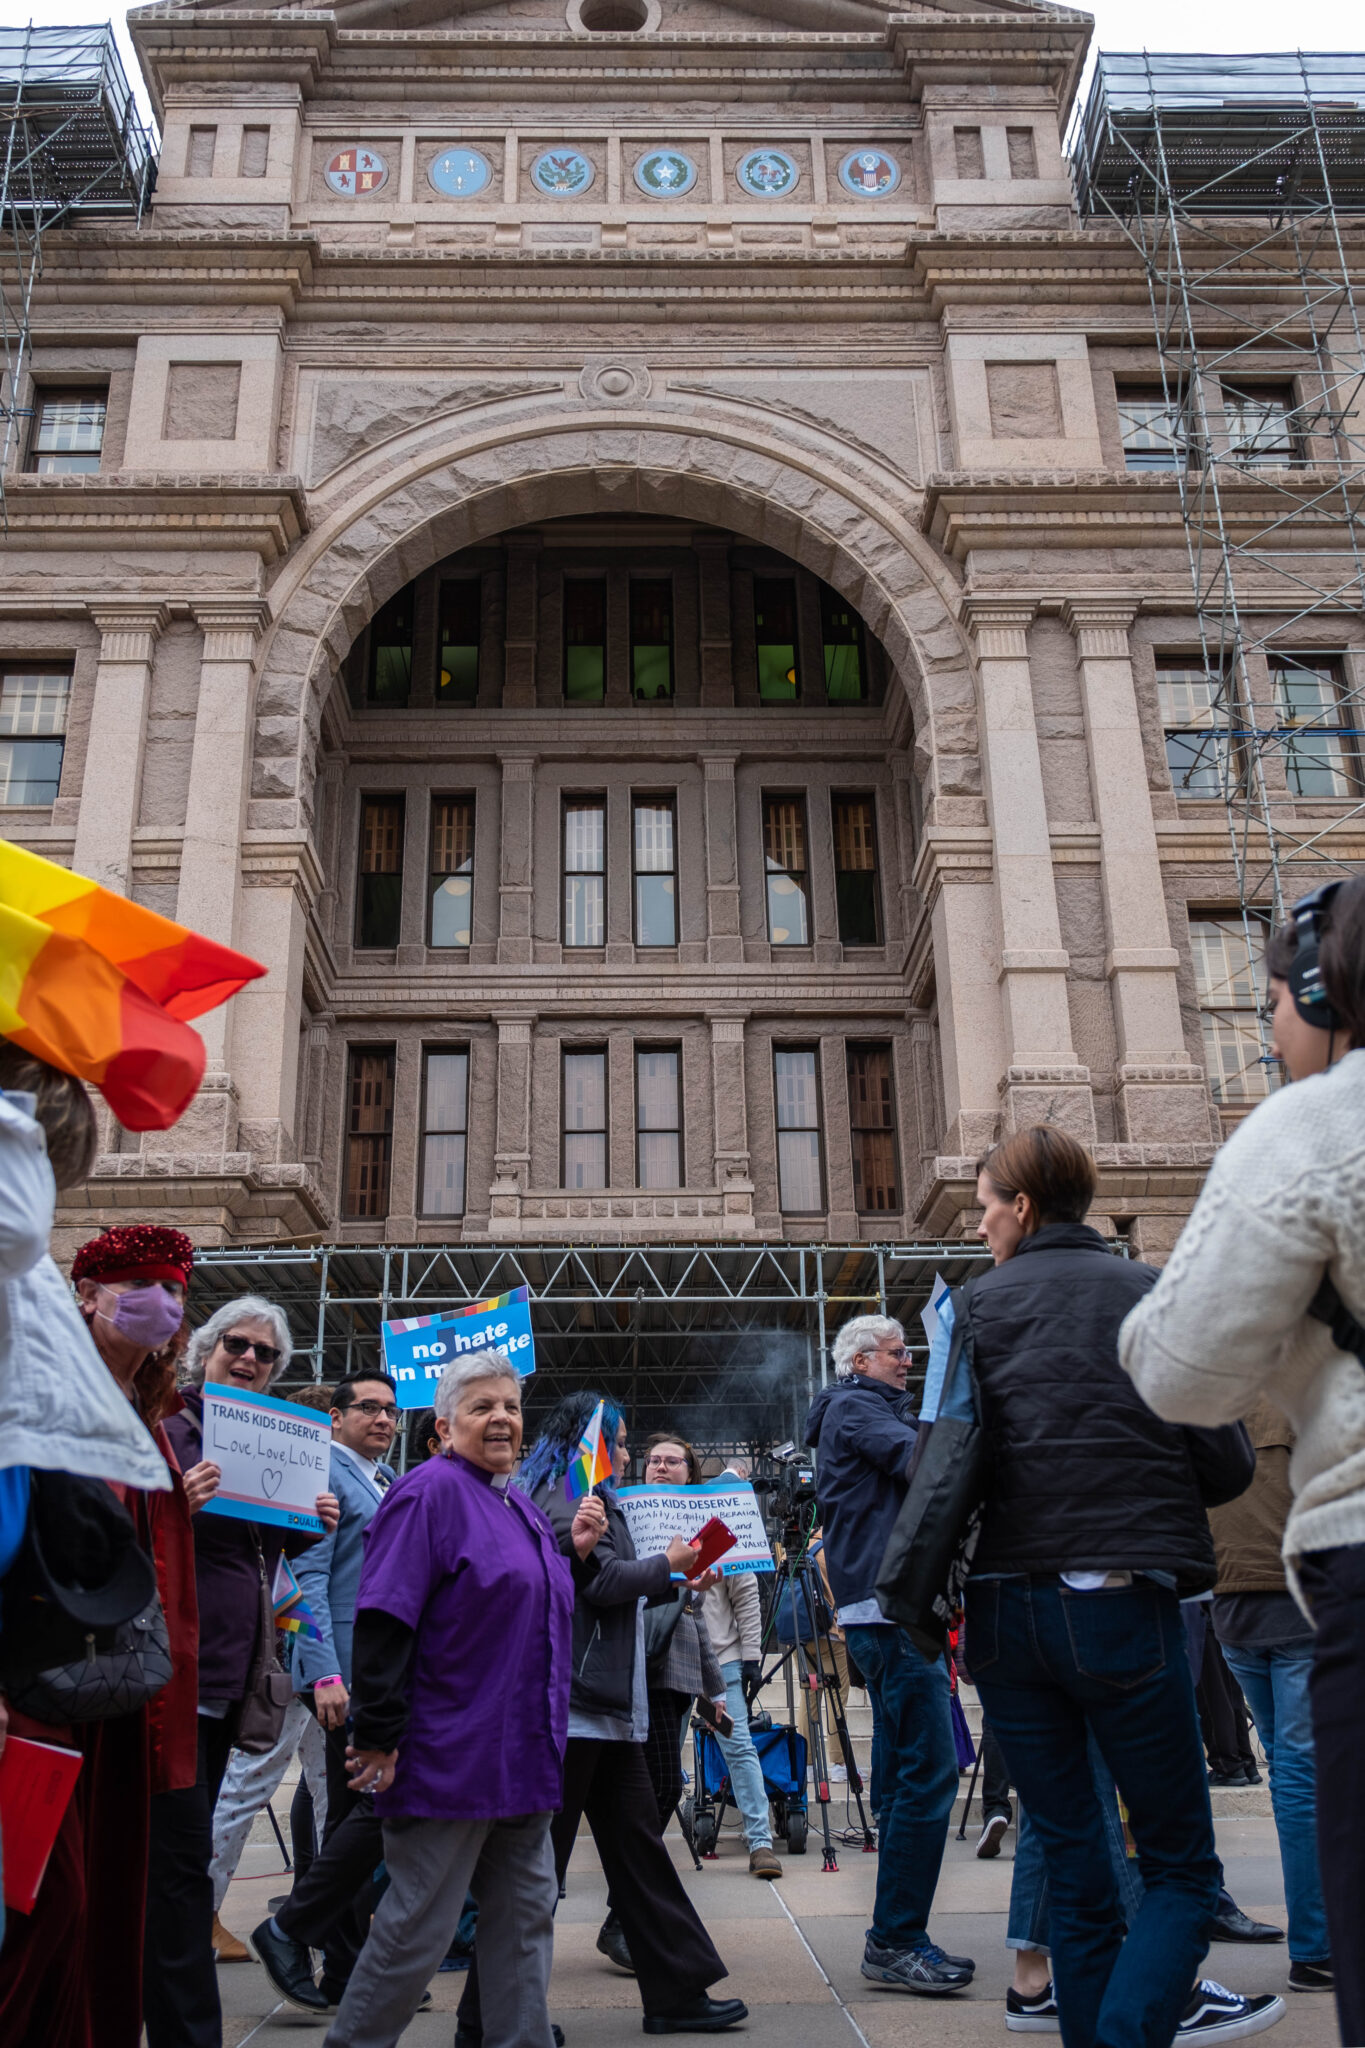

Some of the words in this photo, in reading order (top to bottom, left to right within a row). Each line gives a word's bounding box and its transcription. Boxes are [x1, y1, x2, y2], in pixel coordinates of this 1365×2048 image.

[412, 1341, 447, 1359] no
[454, 1322, 509, 1353] hate
[390, 1364, 416, 1381] in
[424, 1362, 448, 1379] m
[211, 1403, 250, 1423] TRANS
[252, 1413, 276, 1431] KIDS
[278, 1420, 320, 1443] DESERVE
[289, 1443, 326, 1472] LOVE
[619, 1498, 660, 1513] TRANS
[661, 1499, 687, 1510] KIDS
[688, 1497, 741, 1511] DESERVE
[288, 1514, 326, 1530] EQUALIT
[724, 1560, 772, 1573] EQUALITY
